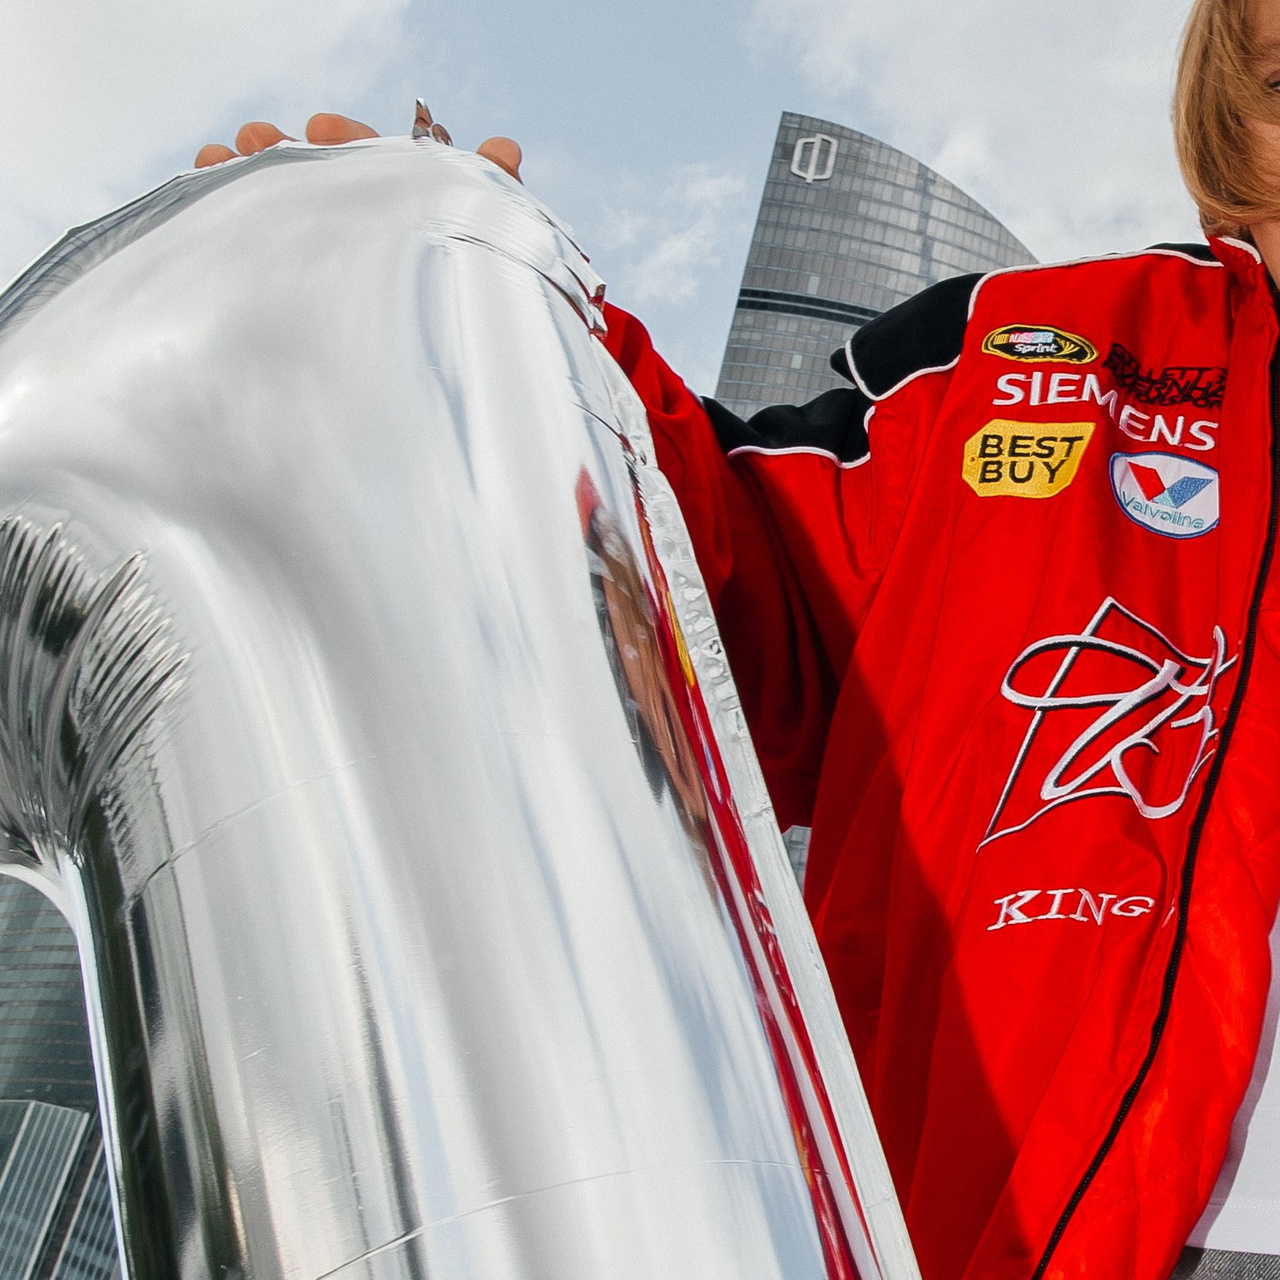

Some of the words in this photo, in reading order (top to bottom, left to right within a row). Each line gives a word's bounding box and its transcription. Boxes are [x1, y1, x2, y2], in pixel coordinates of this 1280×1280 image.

[992, 371, 1219, 451] SIEMENS
[978, 434, 1084, 459] BEST
[978, 459, 1067, 484] BUY
[1122, 490, 1205, 529] Valvoline
[987, 888, 1156, 931] KING
